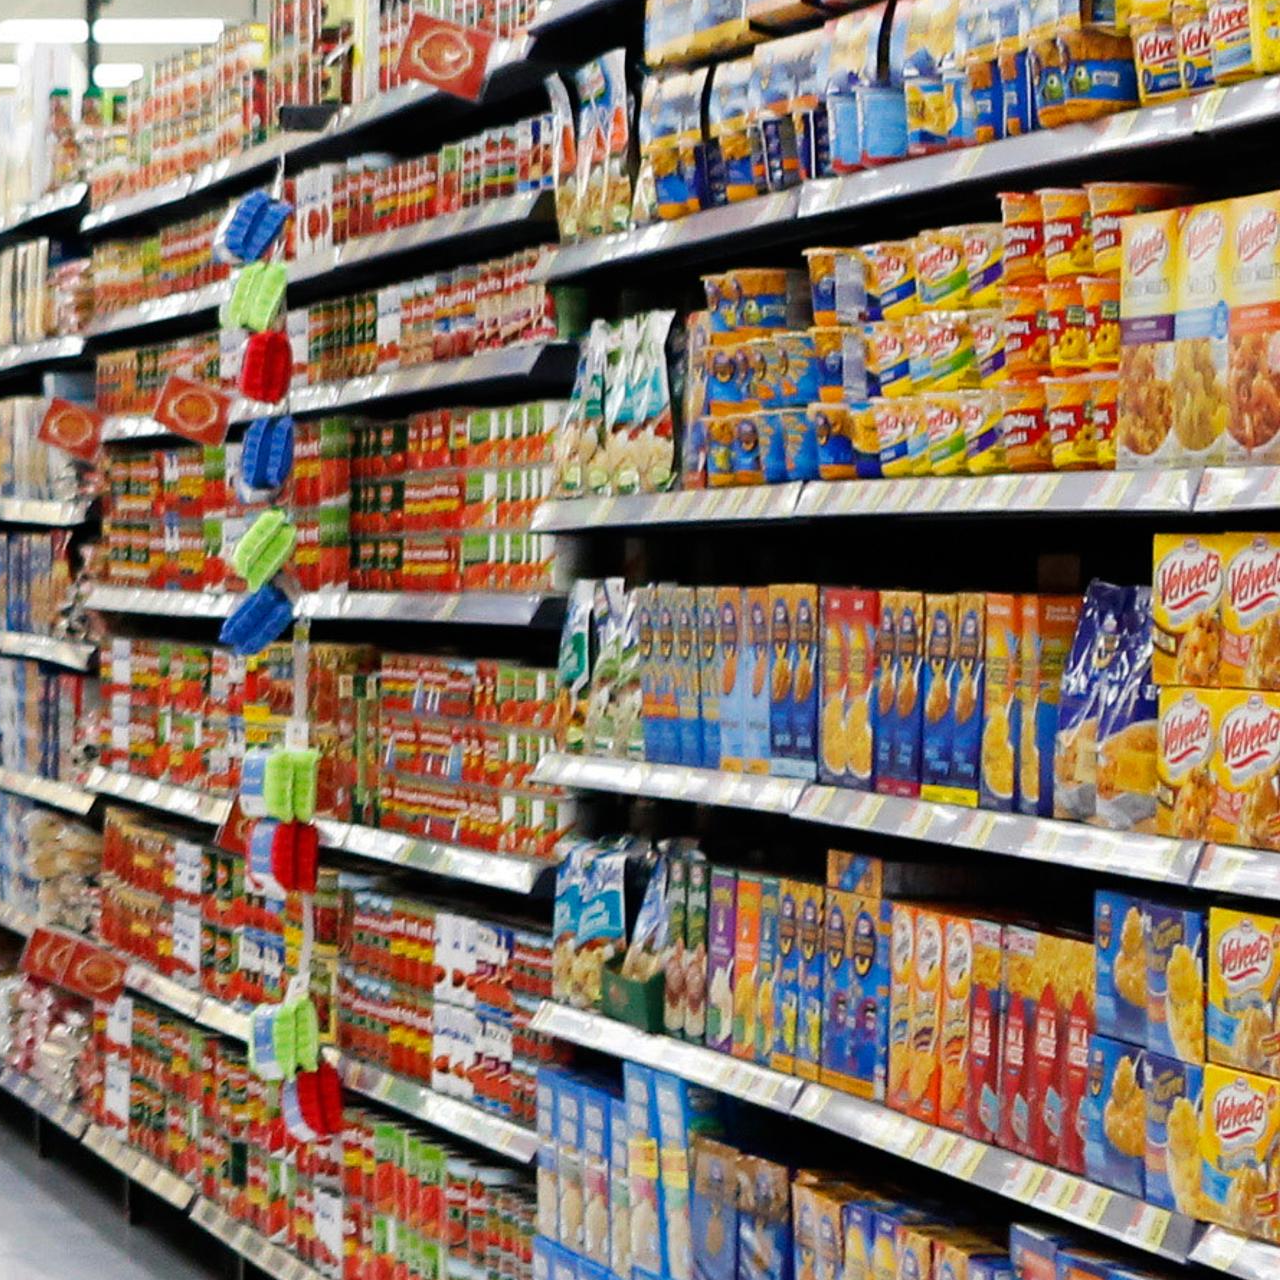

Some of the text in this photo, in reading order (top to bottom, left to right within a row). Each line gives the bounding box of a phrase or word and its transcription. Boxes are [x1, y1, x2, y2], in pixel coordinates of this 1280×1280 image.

[1161, 551, 1219, 606] Velveeta
[1164, 707, 1210, 759] Velveeta
[1224, 710, 1280, 762] Velveeta
[1221, 934, 1270, 975] Velveeta
[1216, 1094, 1264, 1133] Velveeta
